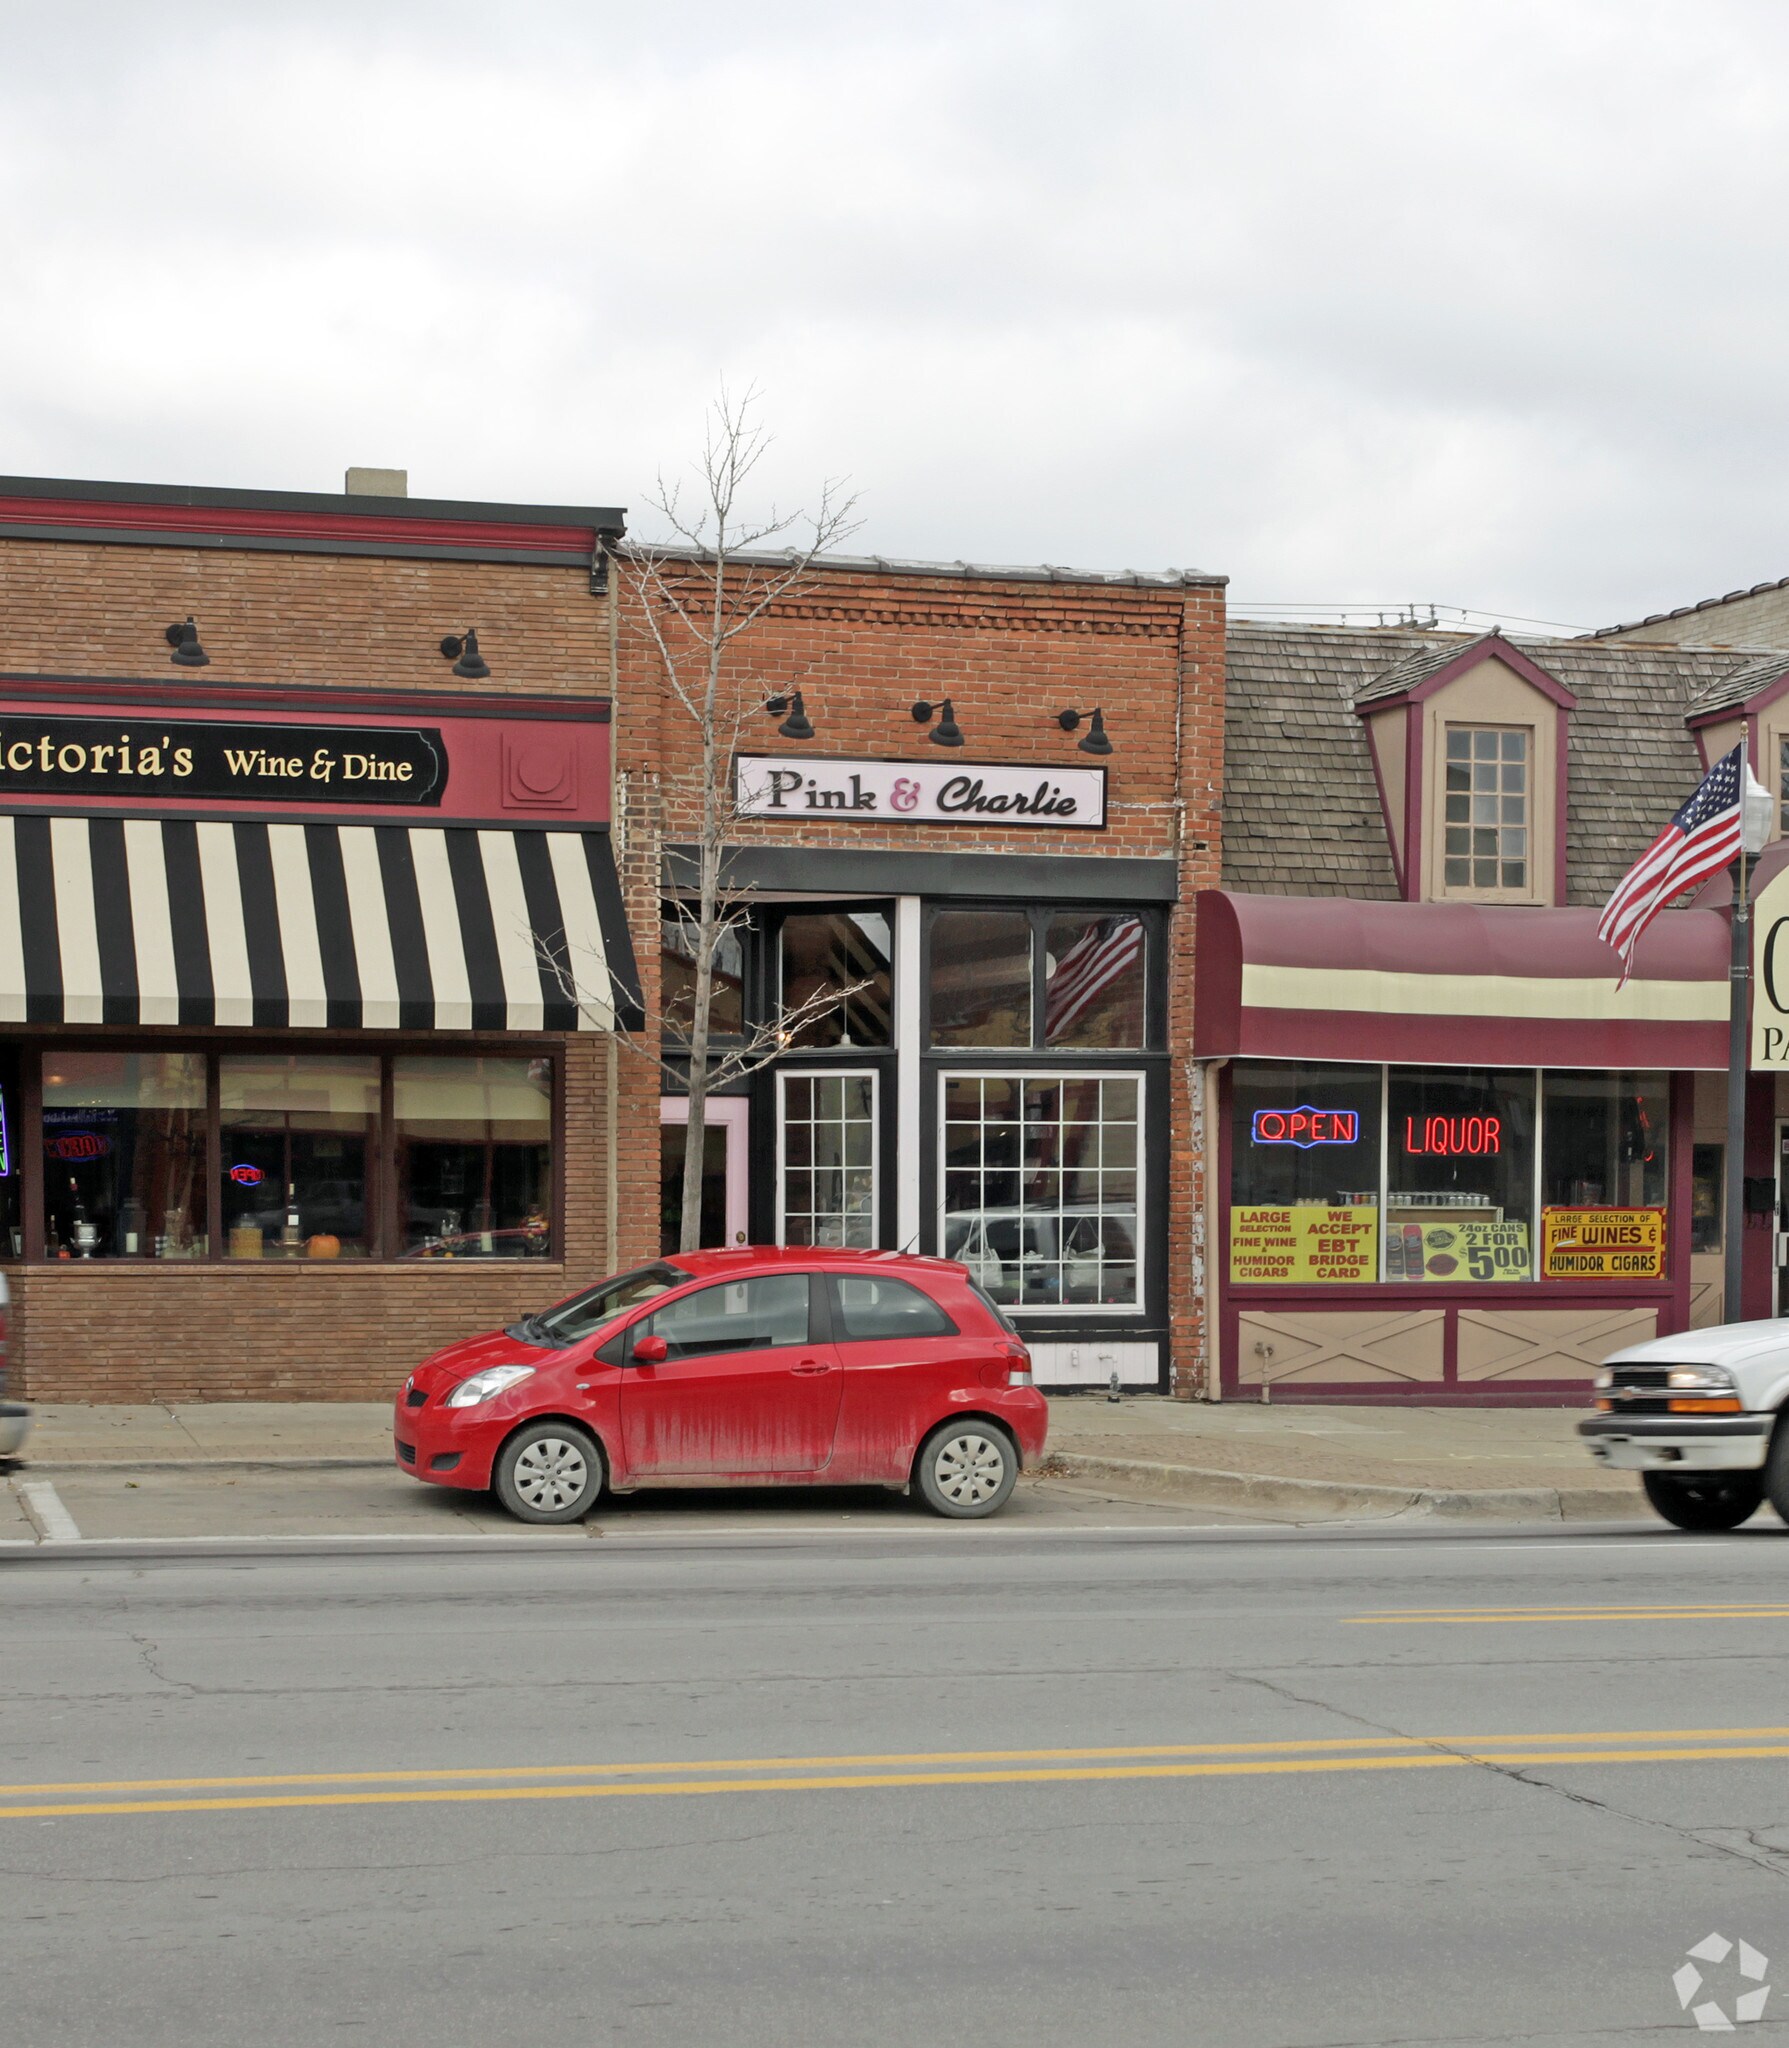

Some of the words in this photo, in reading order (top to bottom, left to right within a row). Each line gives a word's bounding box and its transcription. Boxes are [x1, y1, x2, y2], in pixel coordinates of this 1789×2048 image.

[224, 749, 304, 777] Wine
[310, 749, 336, 783] &
[343, 753, 413, 782] Dine
[767, 770, 878, 811] Pink
[890, 777, 921, 811] &
[936, 775, 1078, 816] Charlie
[1259, 1113, 1353, 1140] OPEN
[1406, 1116, 1500, 1155] LIQUOR
[1240, 1211, 1291, 1223] LARGE
[1327, 1211, 1353, 1222] WE
[1555, 1215, 1582, 1223] LARGE
[1589, 1215, 1634, 1223] SELECTION
[1307, 1224, 1372, 1234] ACCEPT
[1490, 1224, 1524, 1233] CANS
[1466, 1233, 1477, 1245] 2
[1482, 1233, 1518, 1245] FOR
[1552, 1226, 1578, 1243] FINE
[1582, 1226, 1642, 1244] WINES
[1648, 1227, 1657, 1243] &
[1233, 1237, 1261, 1247] FINE
[1264, 1237, 1297, 1247] WINE
[1318, 1239, 1360, 1253] EBT
[1233, 1256, 1295, 1266] HUMIDOR
[1309, 1255, 1369, 1266] BRIDGE
[1549, 1256, 1604, 1271] HUMIDOR
[1611, 1255, 1656, 1271] CIGARS
[1239, 1267, 1289, 1277] CIGARS
[1316, 1268, 1360, 1278] CARD
